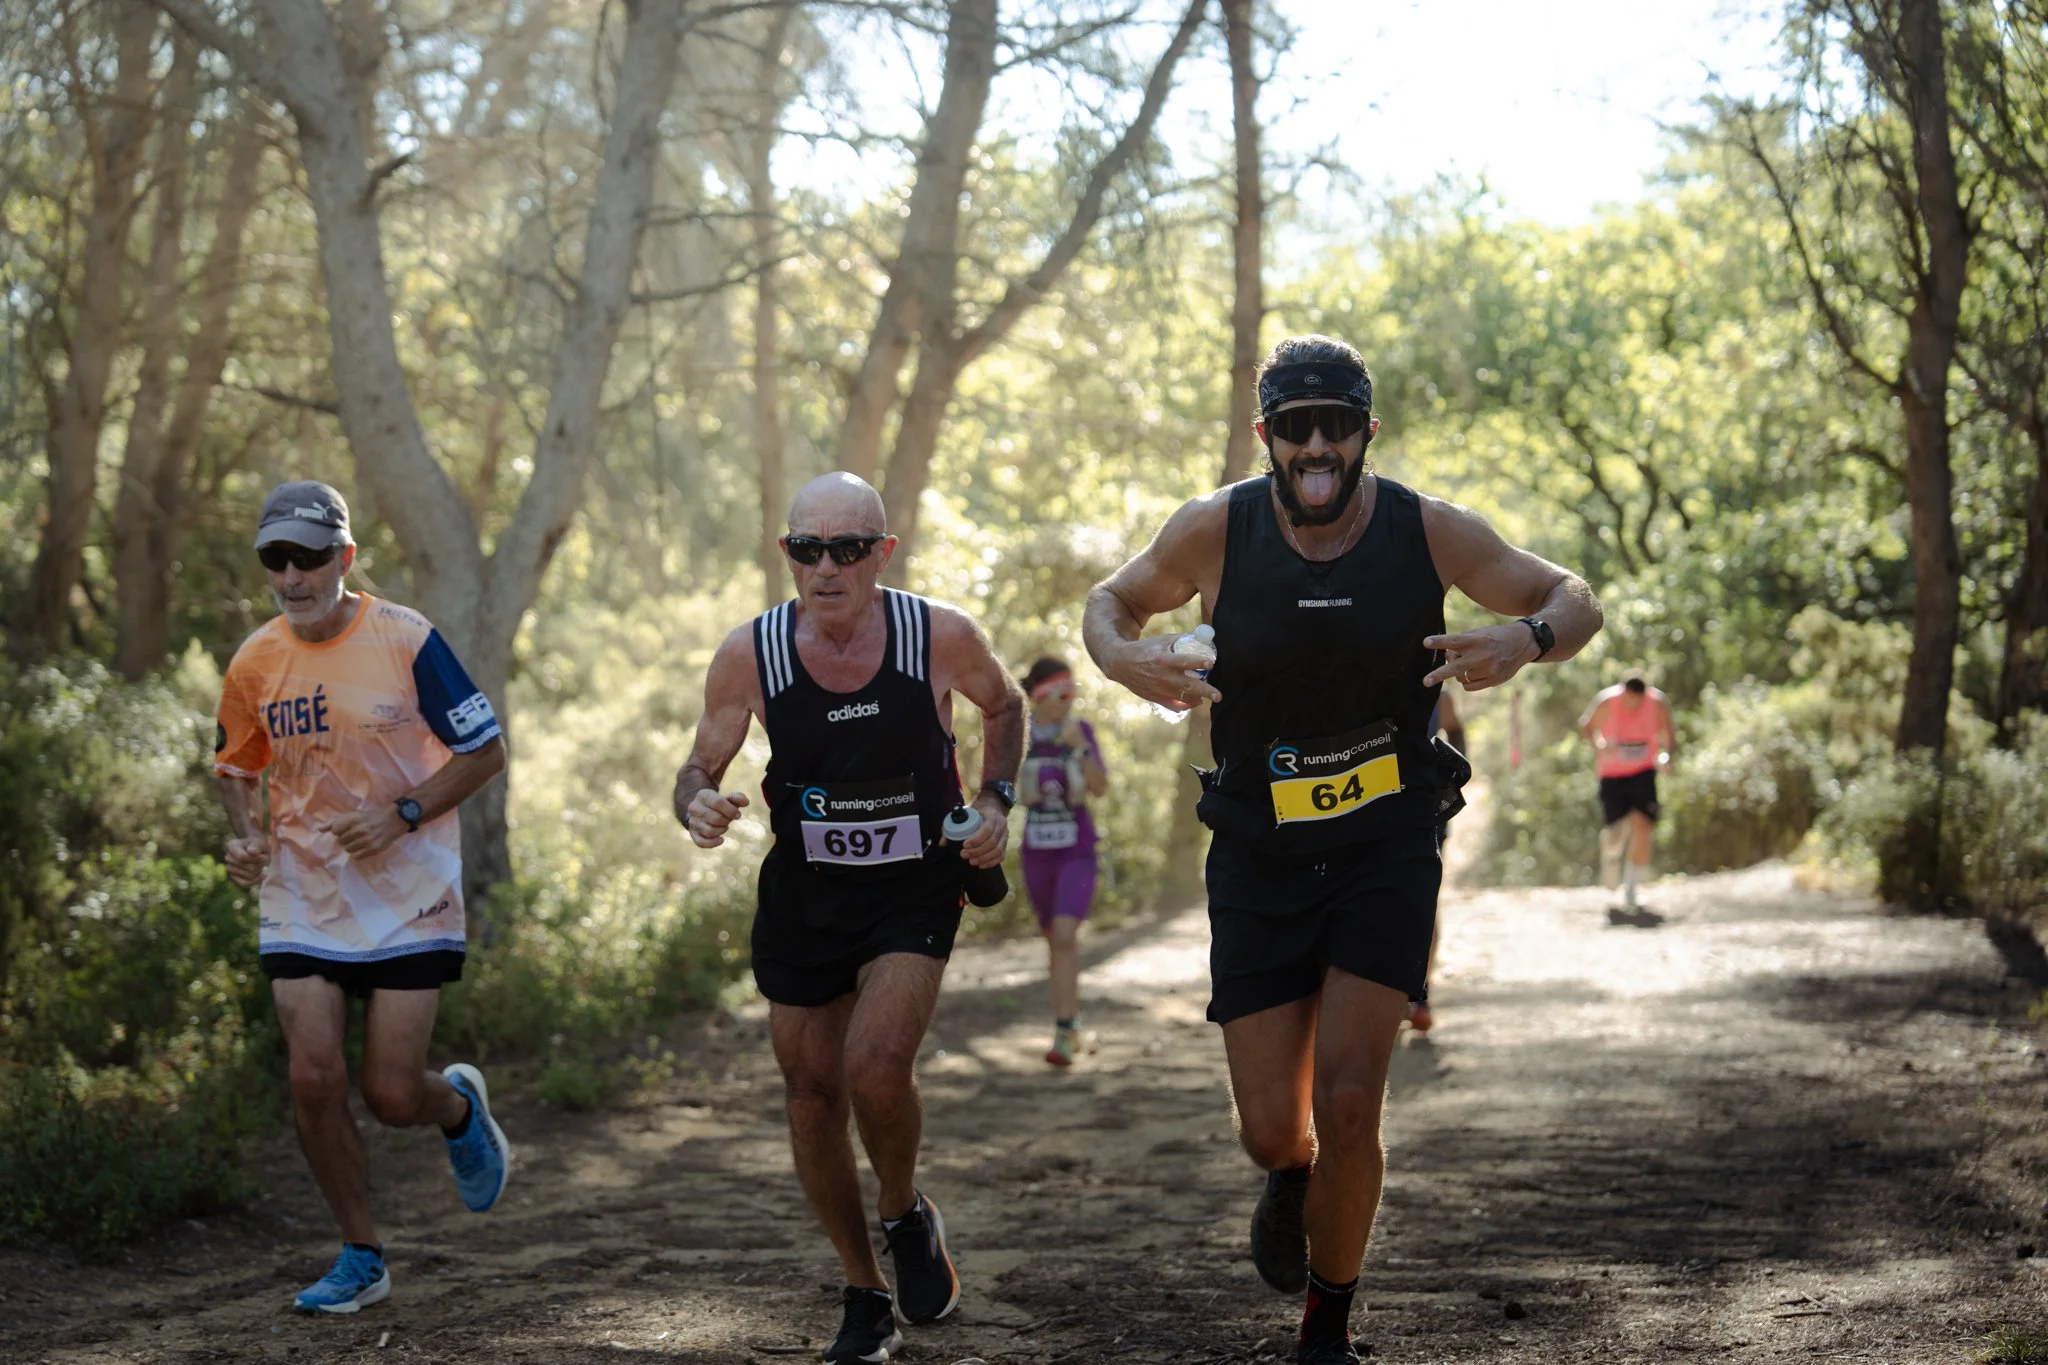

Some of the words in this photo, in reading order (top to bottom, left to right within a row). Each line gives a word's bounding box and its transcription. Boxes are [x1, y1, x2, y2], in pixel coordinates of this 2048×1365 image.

[261, 684, 330, 738] ENSÉ
[827, 701, 880, 722] adidas
[1304, 733, 1391, 765] runningconseil
[831, 792, 914, 811] runningconseil
[1311, 773, 1364, 811] 64
[824, 826, 898, 858] 697
